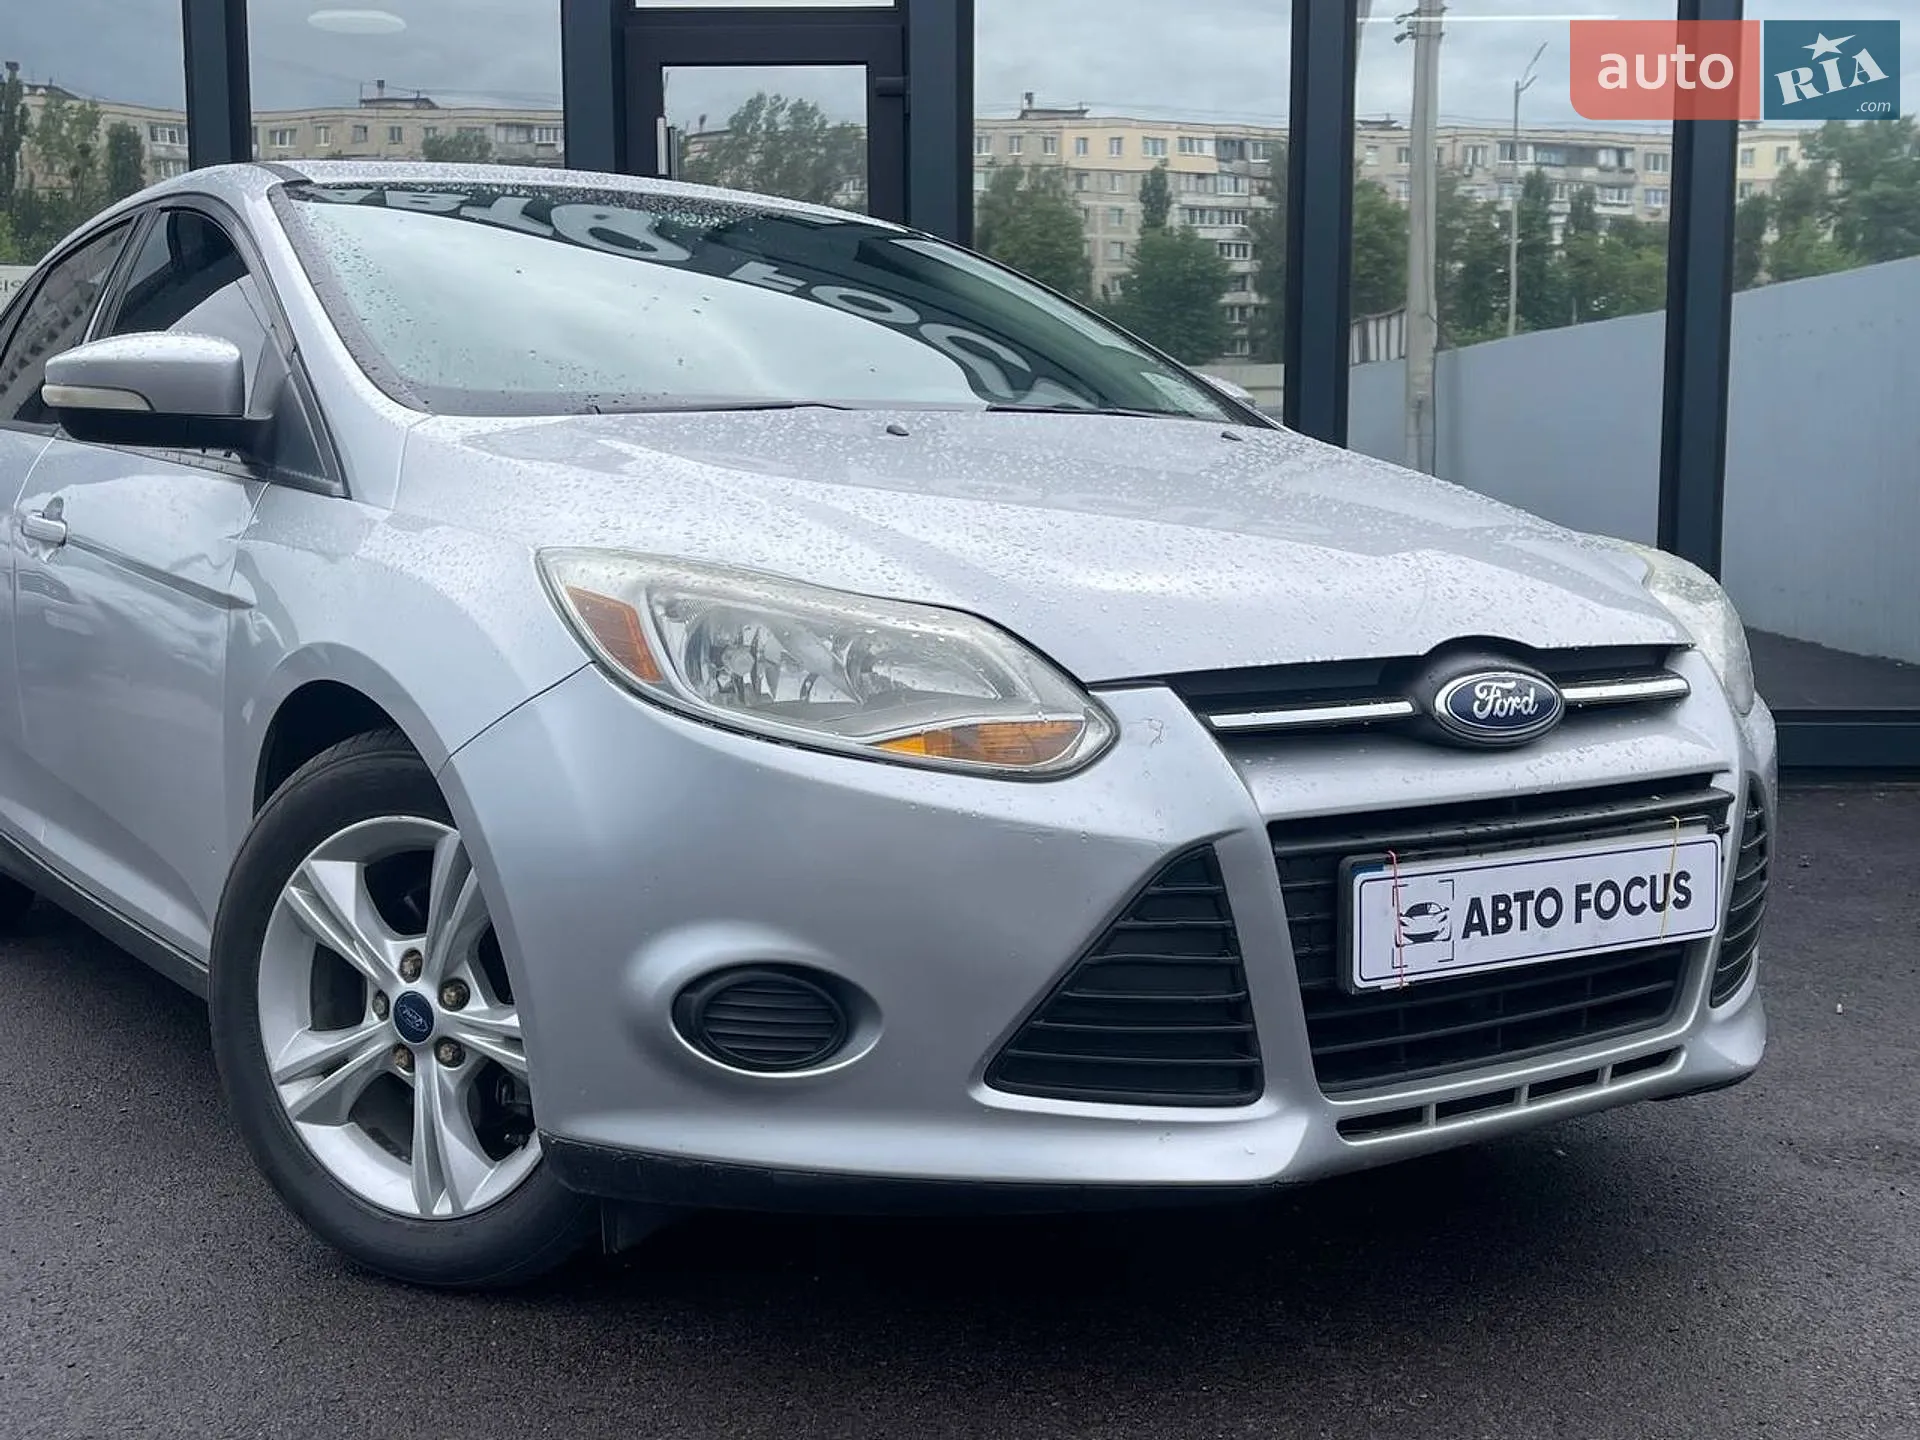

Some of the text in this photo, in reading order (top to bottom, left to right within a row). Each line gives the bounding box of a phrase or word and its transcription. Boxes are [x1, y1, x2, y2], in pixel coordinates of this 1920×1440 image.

[1473, 681, 1538, 719] Ford
[1461, 870, 1692, 939] АВТО FOCUS
